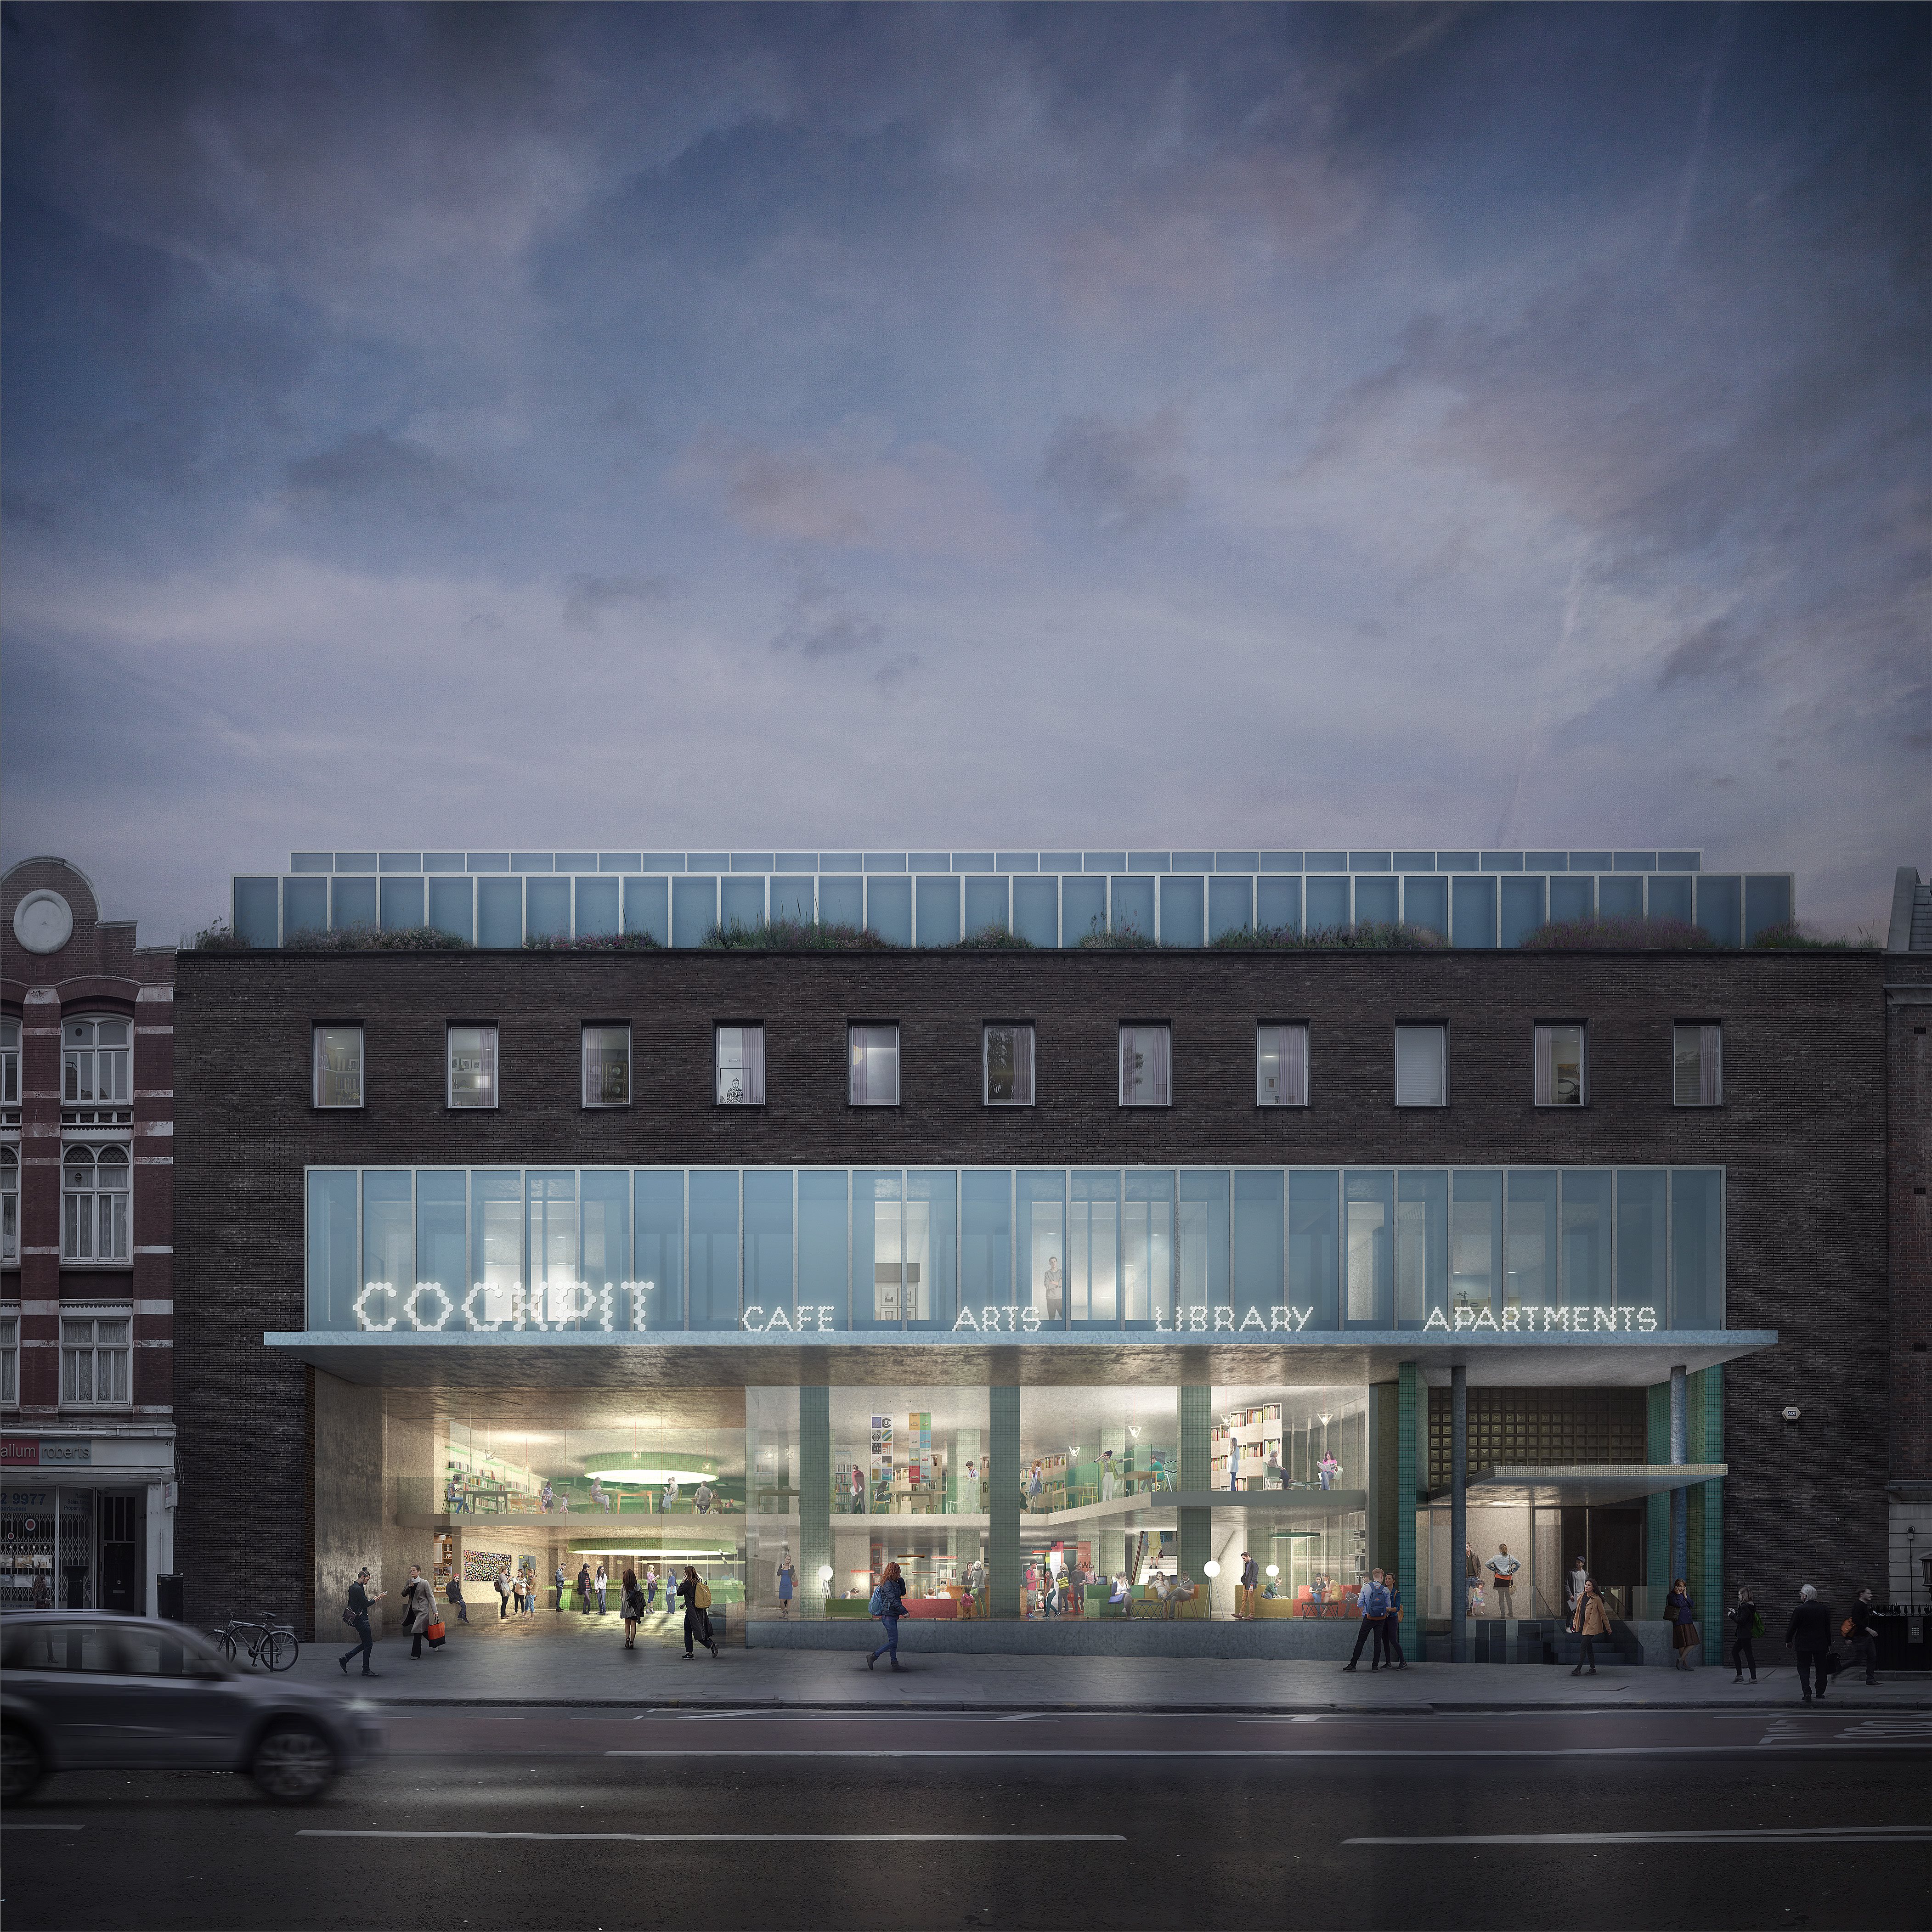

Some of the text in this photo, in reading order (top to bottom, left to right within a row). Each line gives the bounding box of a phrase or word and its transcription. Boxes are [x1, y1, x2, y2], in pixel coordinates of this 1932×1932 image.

[353, 1281, 655, 1332] COCKPIT
[742, 1306, 835, 1332] CAFE
[952, 1306, 1041, 1332] ARTS
[1155, 1306, 1313, 1332] LIBRARY
[1423, 1306, 1657, 1332] APARTMENTS
[42, 1445, 90, 1458] roberts
[12, 1493, 45, 1505] 9977
